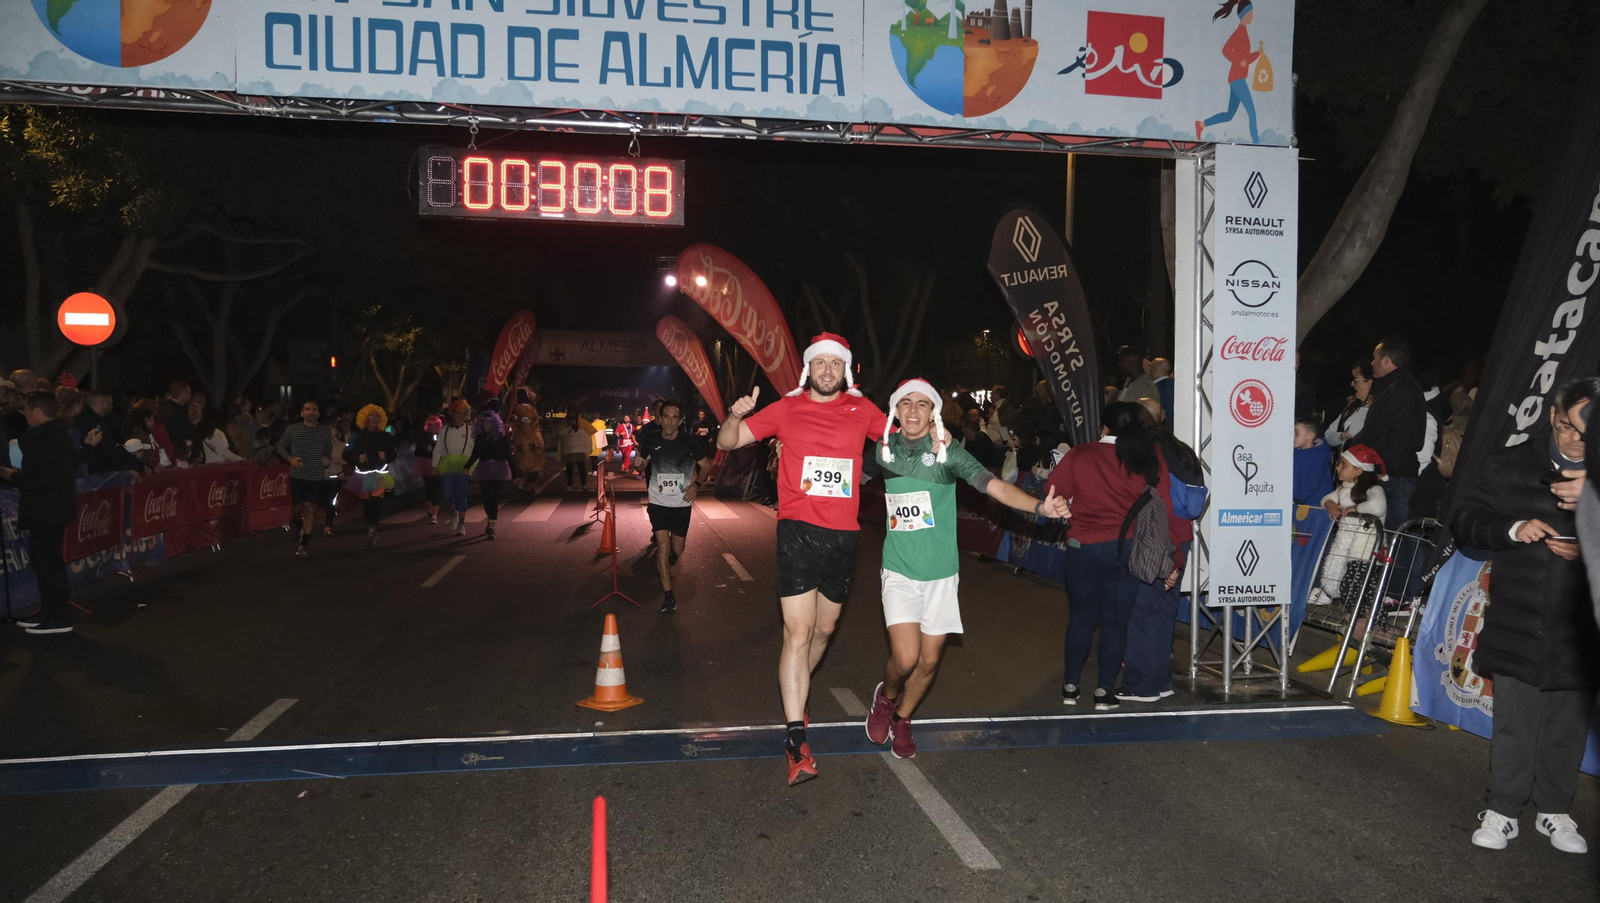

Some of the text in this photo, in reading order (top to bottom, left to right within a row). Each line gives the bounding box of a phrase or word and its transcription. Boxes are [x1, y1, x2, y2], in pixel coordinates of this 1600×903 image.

[264, 11, 487, 79] CIUDAD
[507, 25, 581, 84] DE
[599, 31, 846, 97] ALMERÍA
[1225, 215, 1285, 228] RENAULT
[1225, 226, 1284, 237] SYRSA AUTOMOCION
[1226, 278, 1281, 289] NISSAN
[1231, 309, 1279, 318] andalmotor.es
[492, 313, 533, 386] Coca-Cola
[580, 337, 647, 353] ALMERÍA
[1220, 335, 1289, 362] Coca-Cola
[813, 469, 842, 484] 399
[895, 505, 920, 518] 400
[1220, 511, 1264, 525] Almericar
[1218, 584, 1276, 595] RENAULT
[1218, 595, 1276, 604] SYRSA AUTOMOCION
[1452, 692, 1473, 704] CIUDAD
